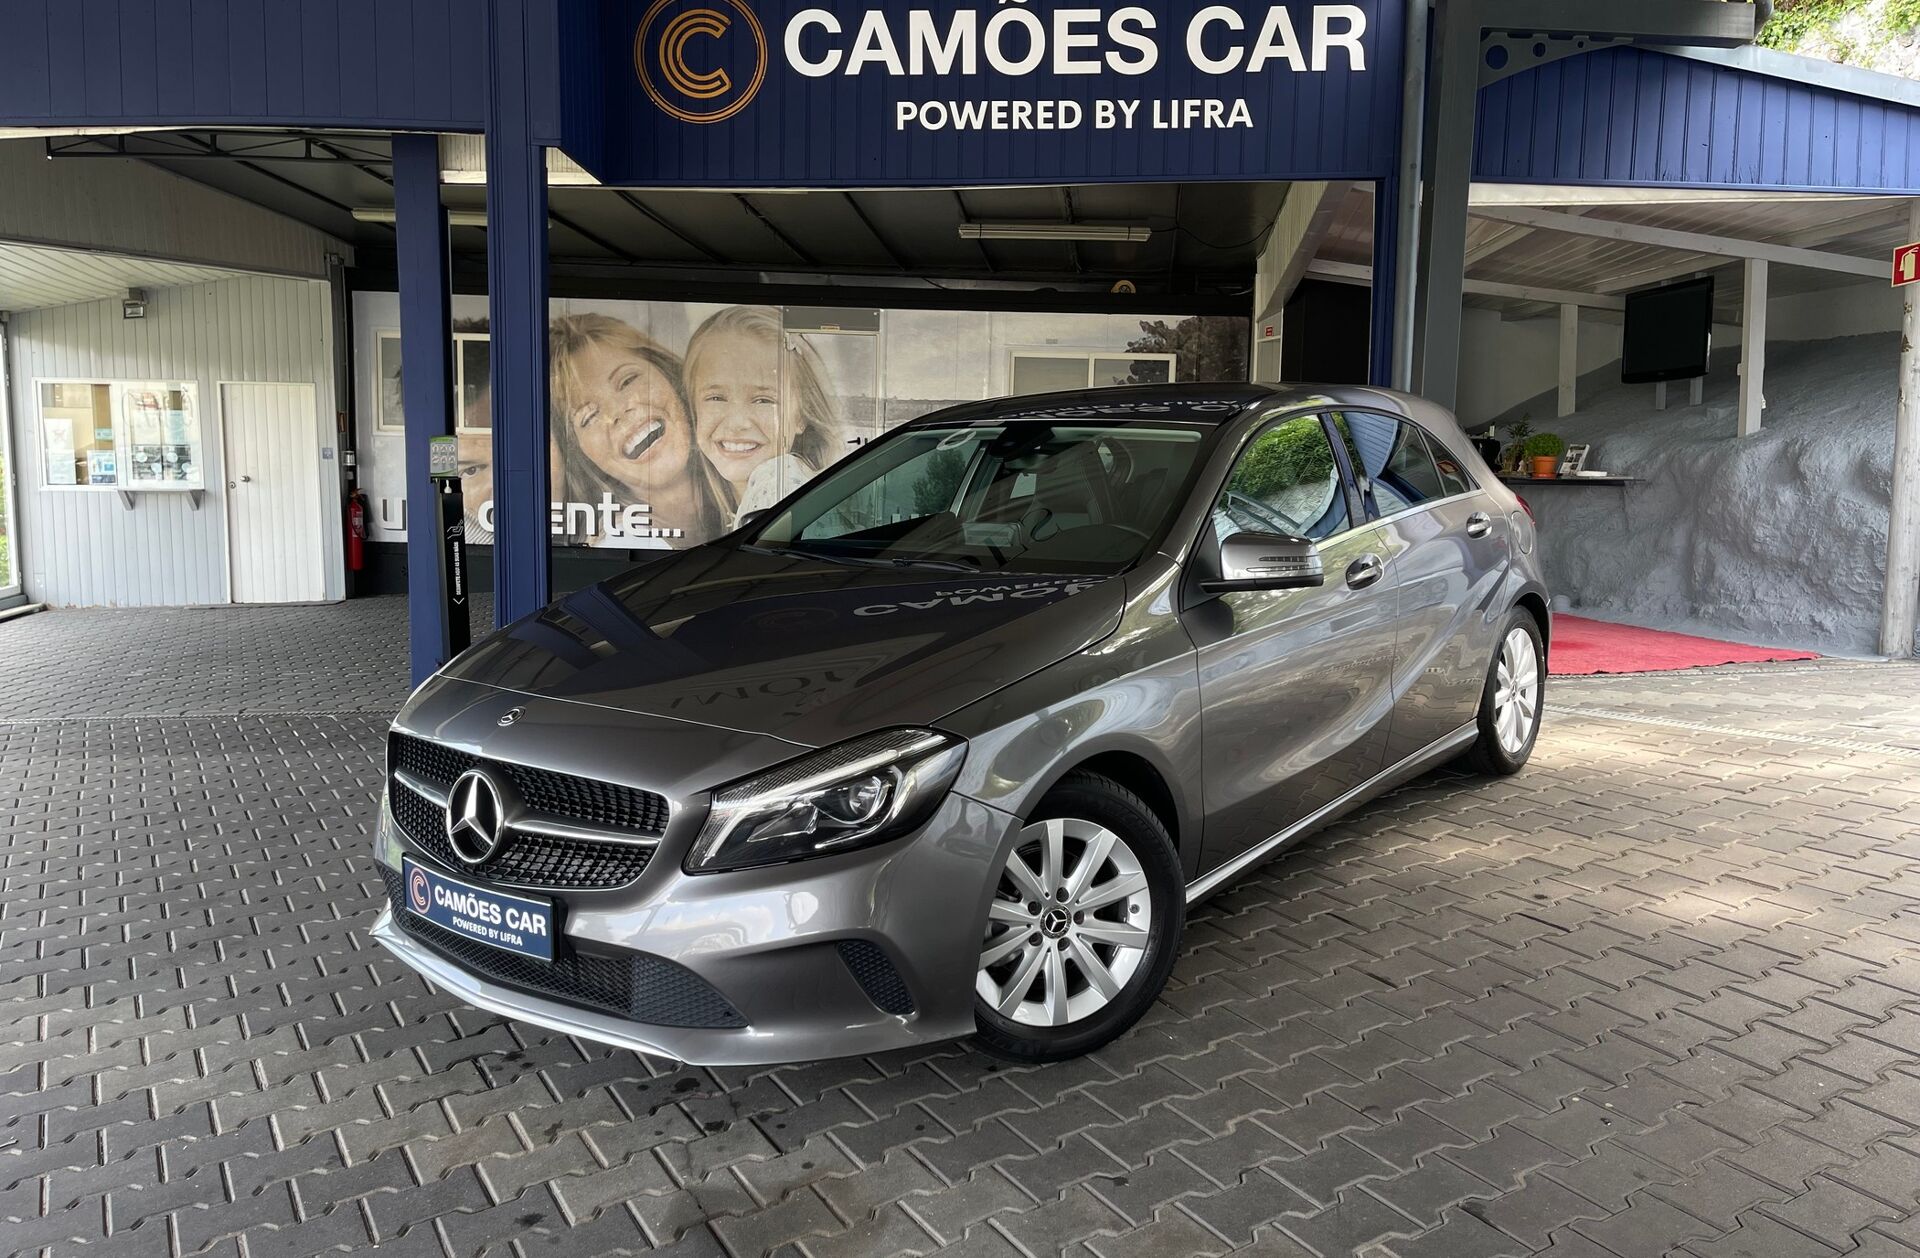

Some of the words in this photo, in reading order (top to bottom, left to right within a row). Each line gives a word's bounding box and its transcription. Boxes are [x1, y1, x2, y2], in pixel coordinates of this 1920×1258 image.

[784, 0, 1159, 78] CAMÕES
[1186, 4, 1367, 75] CAR
[896, 100, 1083, 131] POWERED
[1095, 99, 1141, 130] BY
[1153, 99, 1254, 129] LIFRA
[434, 884, 501, 925] CAMÕES
[505, 908, 547, 937] CAR
[452, 916, 487, 937] POWERED
[488, 928, 499, 940] BY
[500, 931, 523, 946] LIFRA
